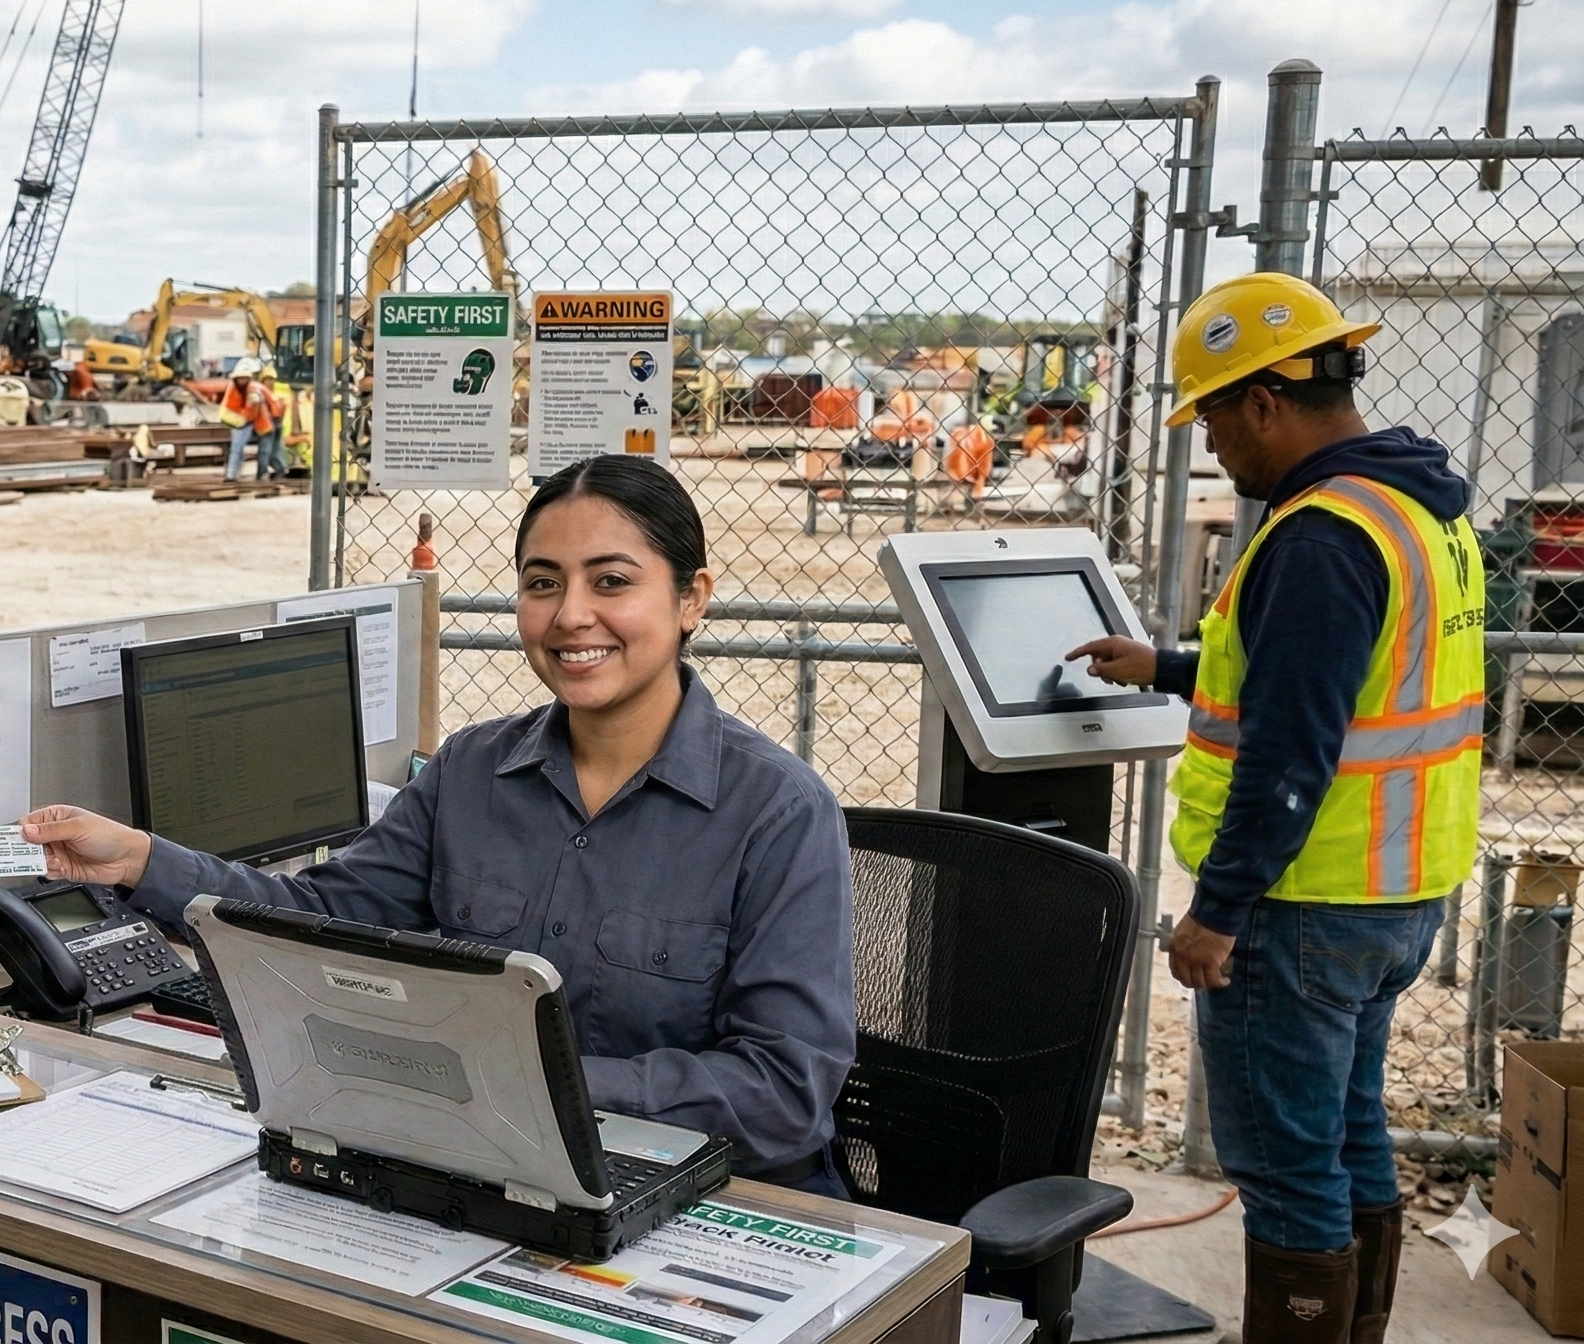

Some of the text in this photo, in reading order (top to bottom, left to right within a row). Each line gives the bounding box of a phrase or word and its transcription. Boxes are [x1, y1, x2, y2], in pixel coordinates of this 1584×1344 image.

[384, 305, 504, 325] SAFETY FIRST
[560, 301, 665, 319] WARNING
[682, 1204, 851, 1250] FETY FIRST
